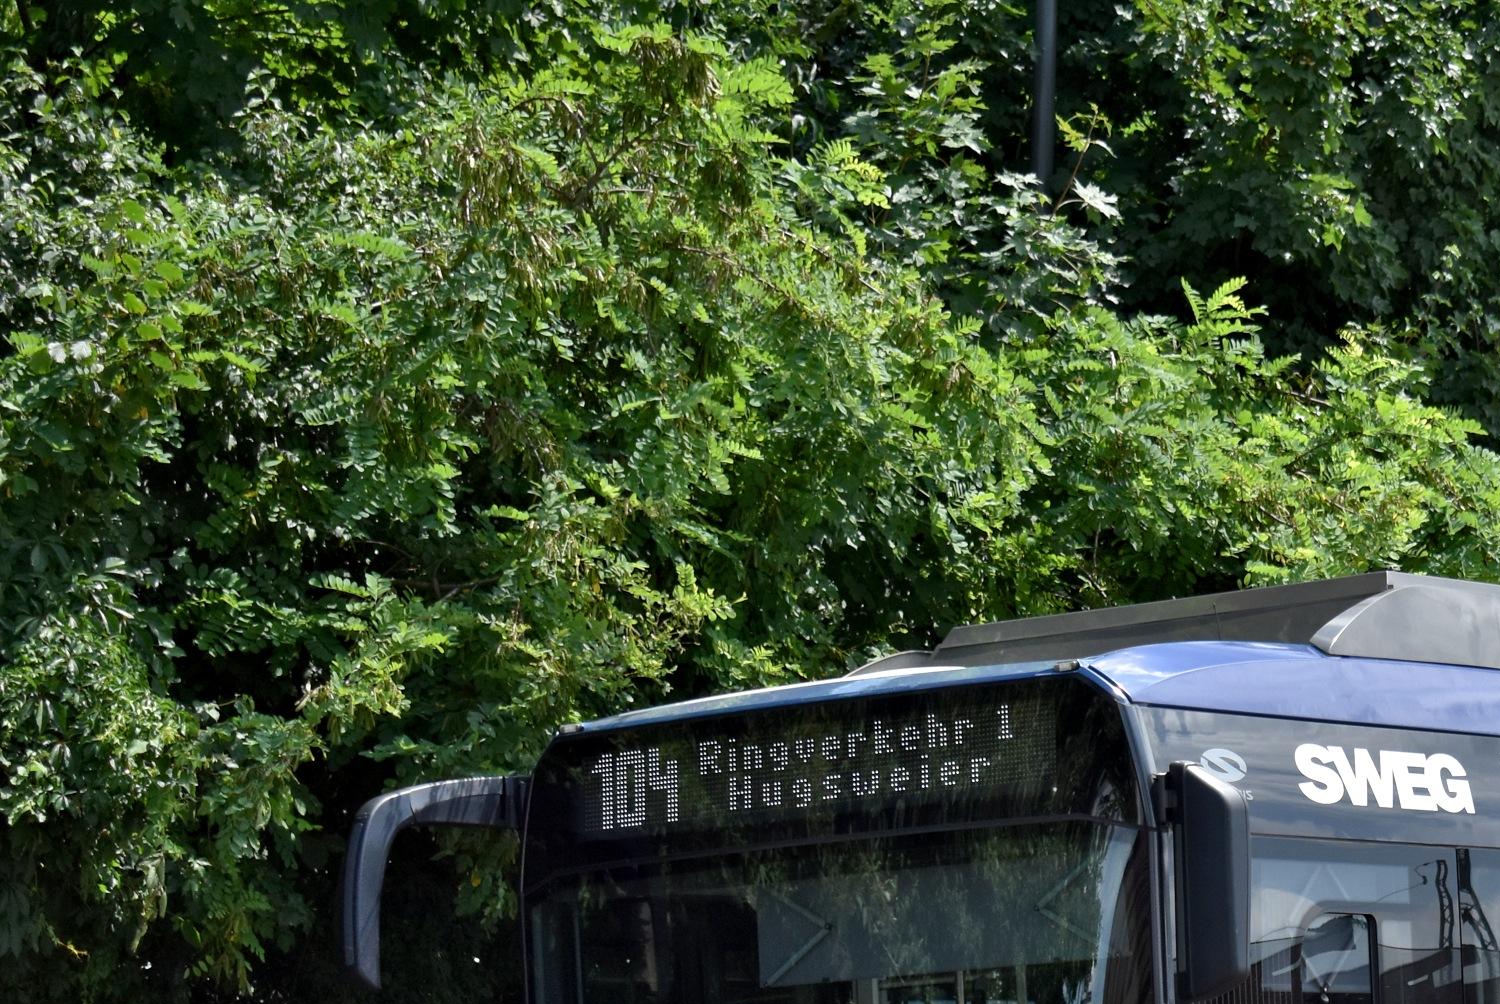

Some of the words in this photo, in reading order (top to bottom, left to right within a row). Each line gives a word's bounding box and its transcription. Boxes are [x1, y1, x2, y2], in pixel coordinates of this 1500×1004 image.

[700, 713, 974, 776] Ringverkehr
[1294, 742, 1476, 814] SWEG
[591, 747, 678, 830] 104
[729, 754, 991, 810] Hugsweier
